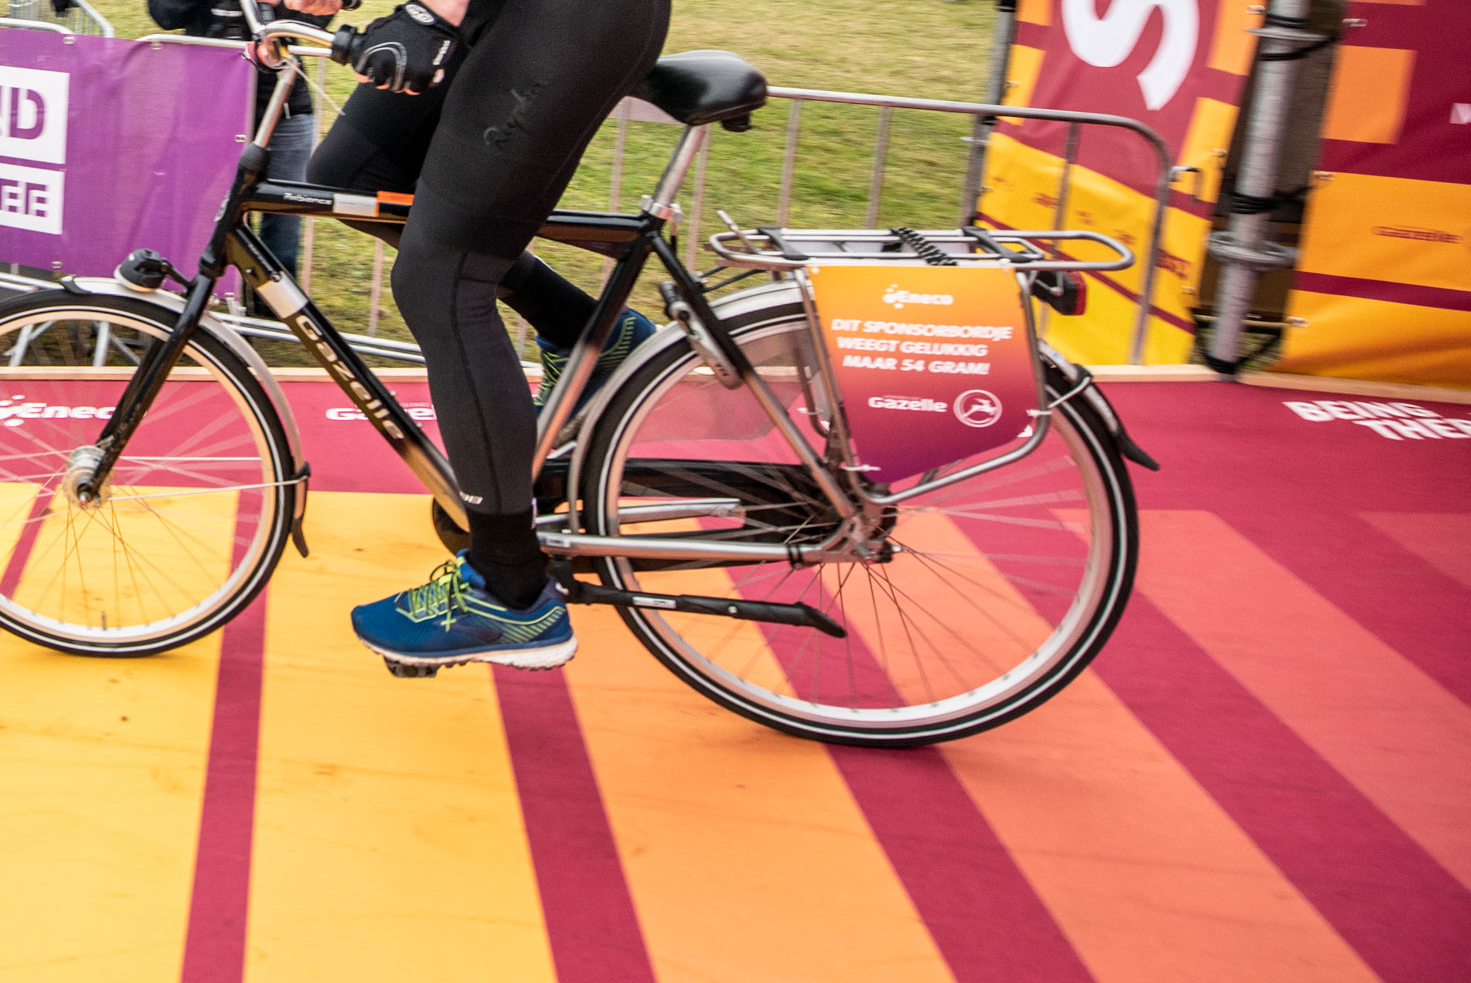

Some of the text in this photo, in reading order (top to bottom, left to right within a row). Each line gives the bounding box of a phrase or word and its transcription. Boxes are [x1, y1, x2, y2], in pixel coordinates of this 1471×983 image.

[896, 289, 954, 305] Eneco
[831, 318, 1013, 341] DIT SPONSORBORDJE
[836, 336, 988, 356] WEEGT GELUKKIG
[842, 355, 991, 375] MAAR 54 GRAM!
[295, 314, 405, 440] Gazelle
[868, 397, 948, 412] Gazelle
[1282, 400, 1443, 422] BEING
